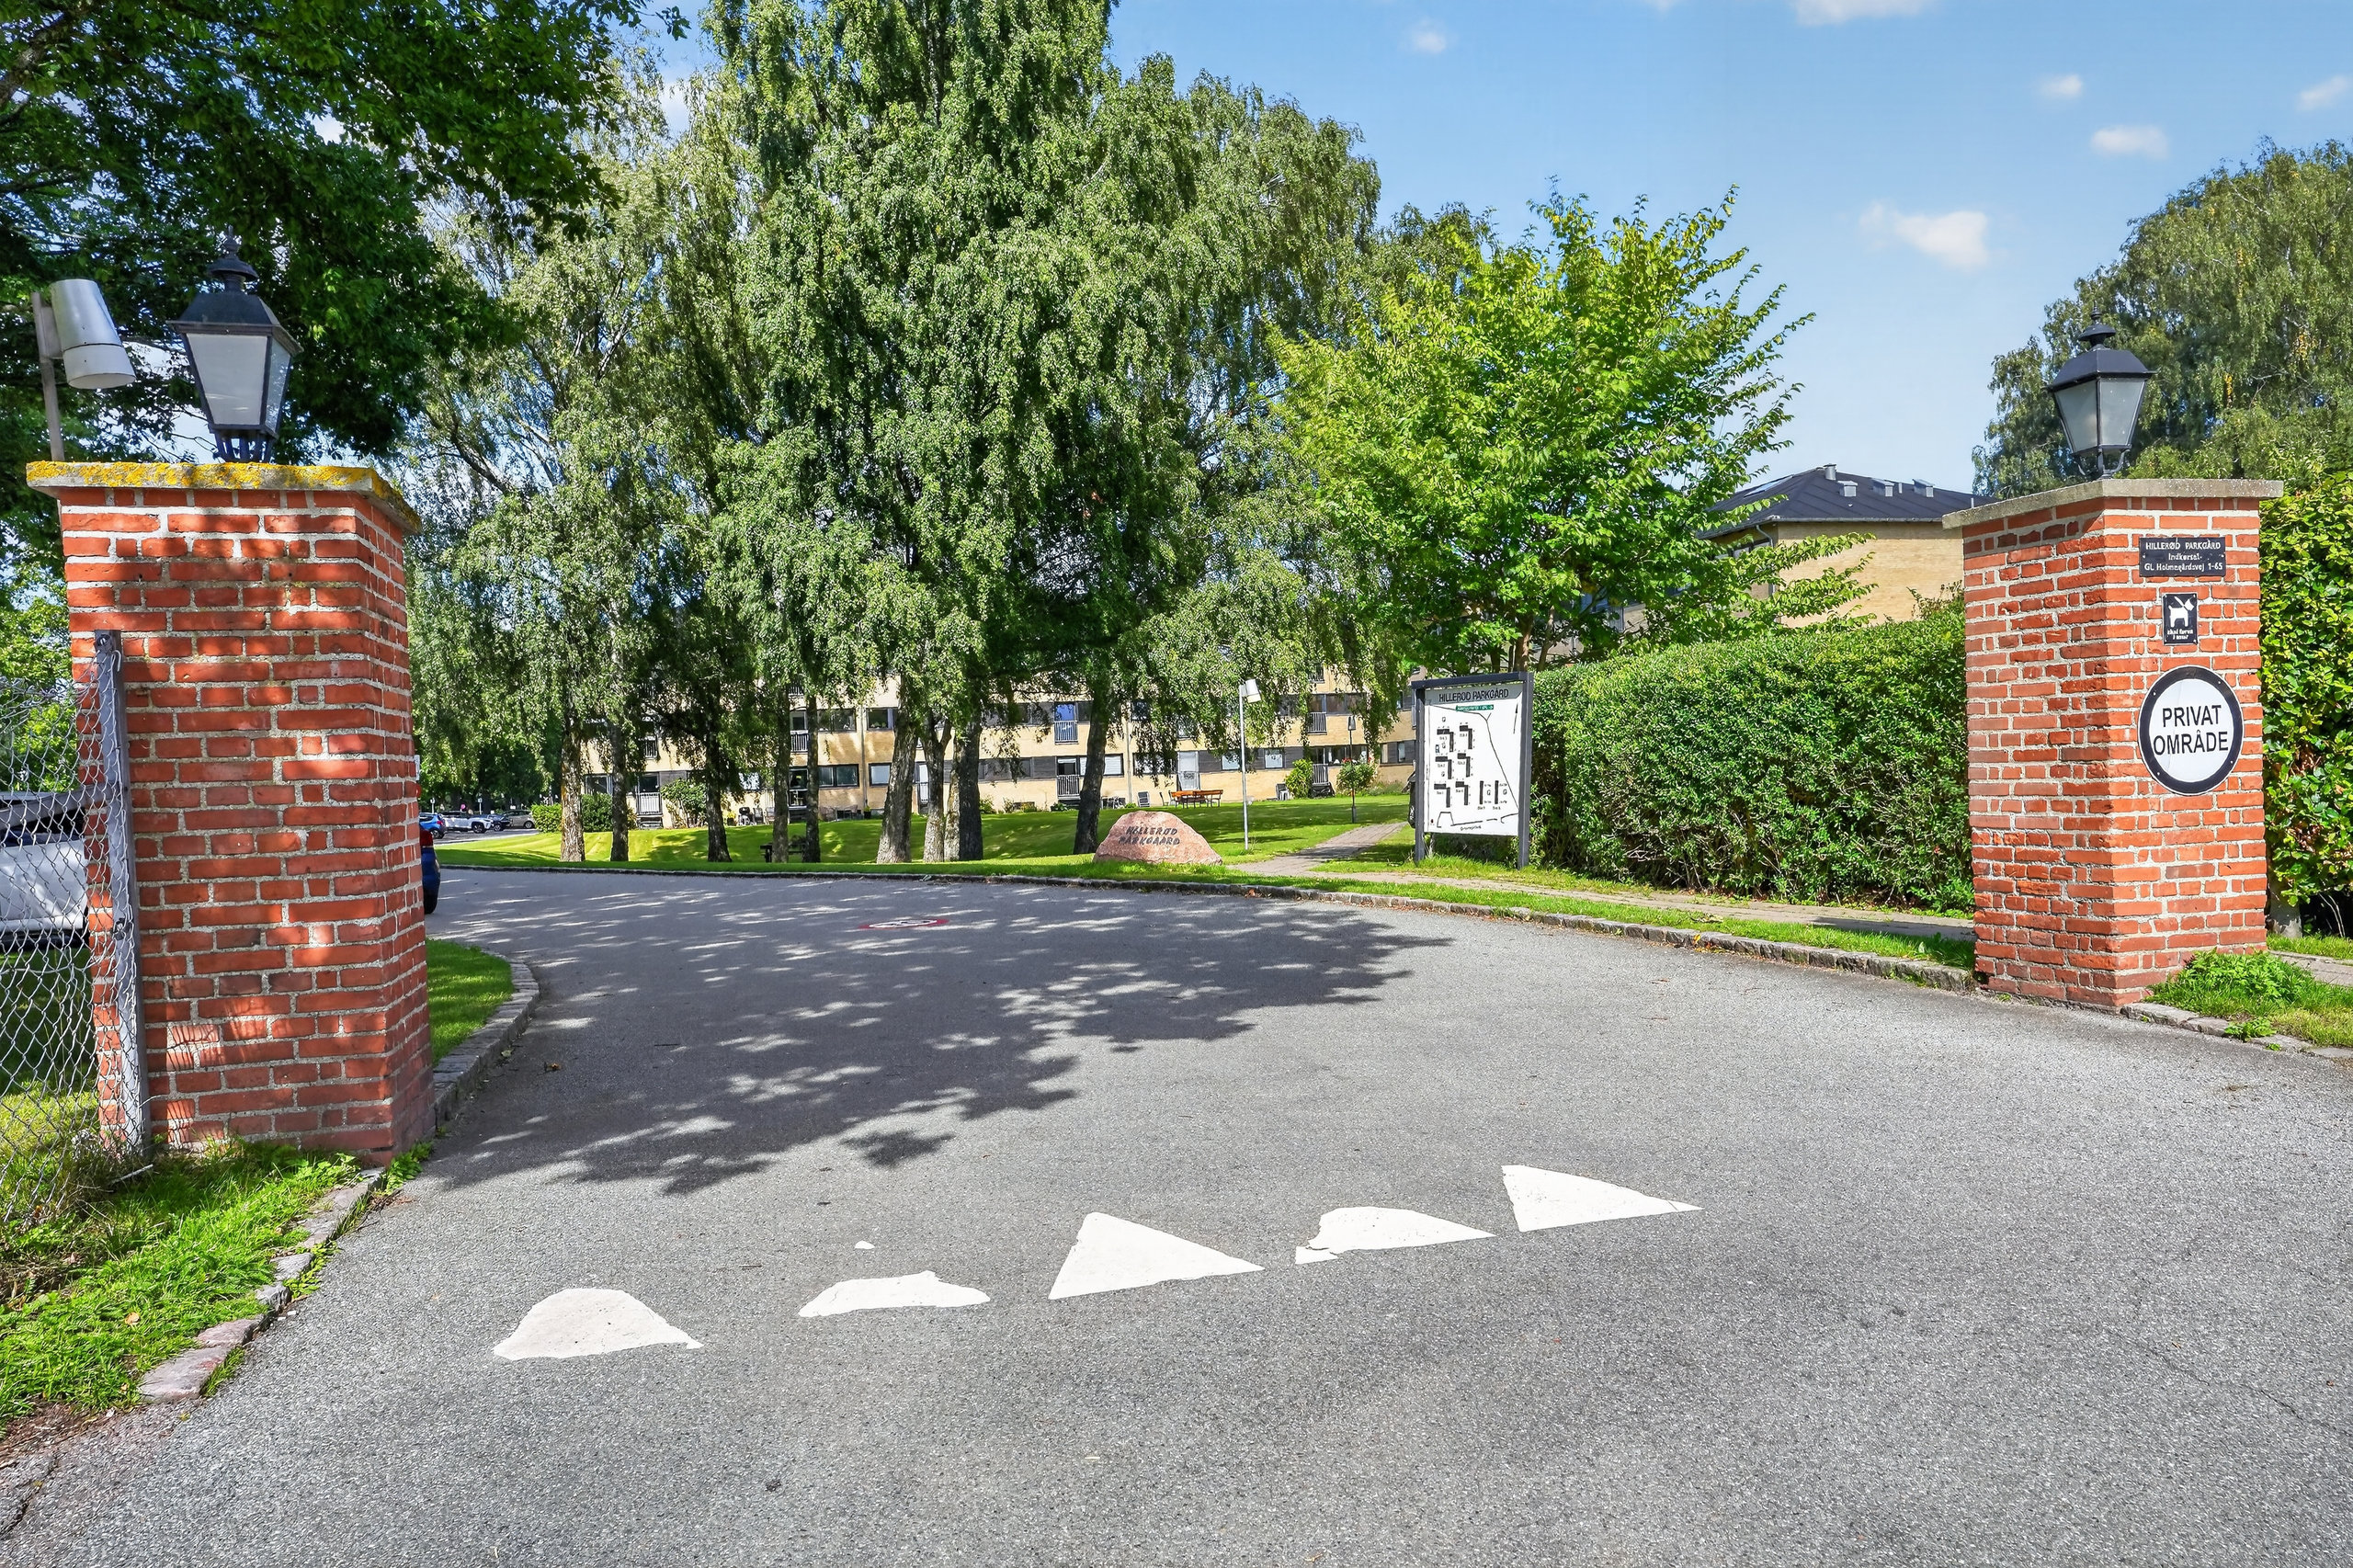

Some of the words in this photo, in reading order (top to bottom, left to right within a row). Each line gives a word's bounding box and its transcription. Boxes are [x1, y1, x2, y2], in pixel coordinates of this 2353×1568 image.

[2145, 541, 2181, 550] HILLERØD
[2185, 540, 2221, 550] PARKGÅRD
[2162, 704, 2222, 727] PRIVAT
[2153, 730, 2229, 756] OMRÅDE
